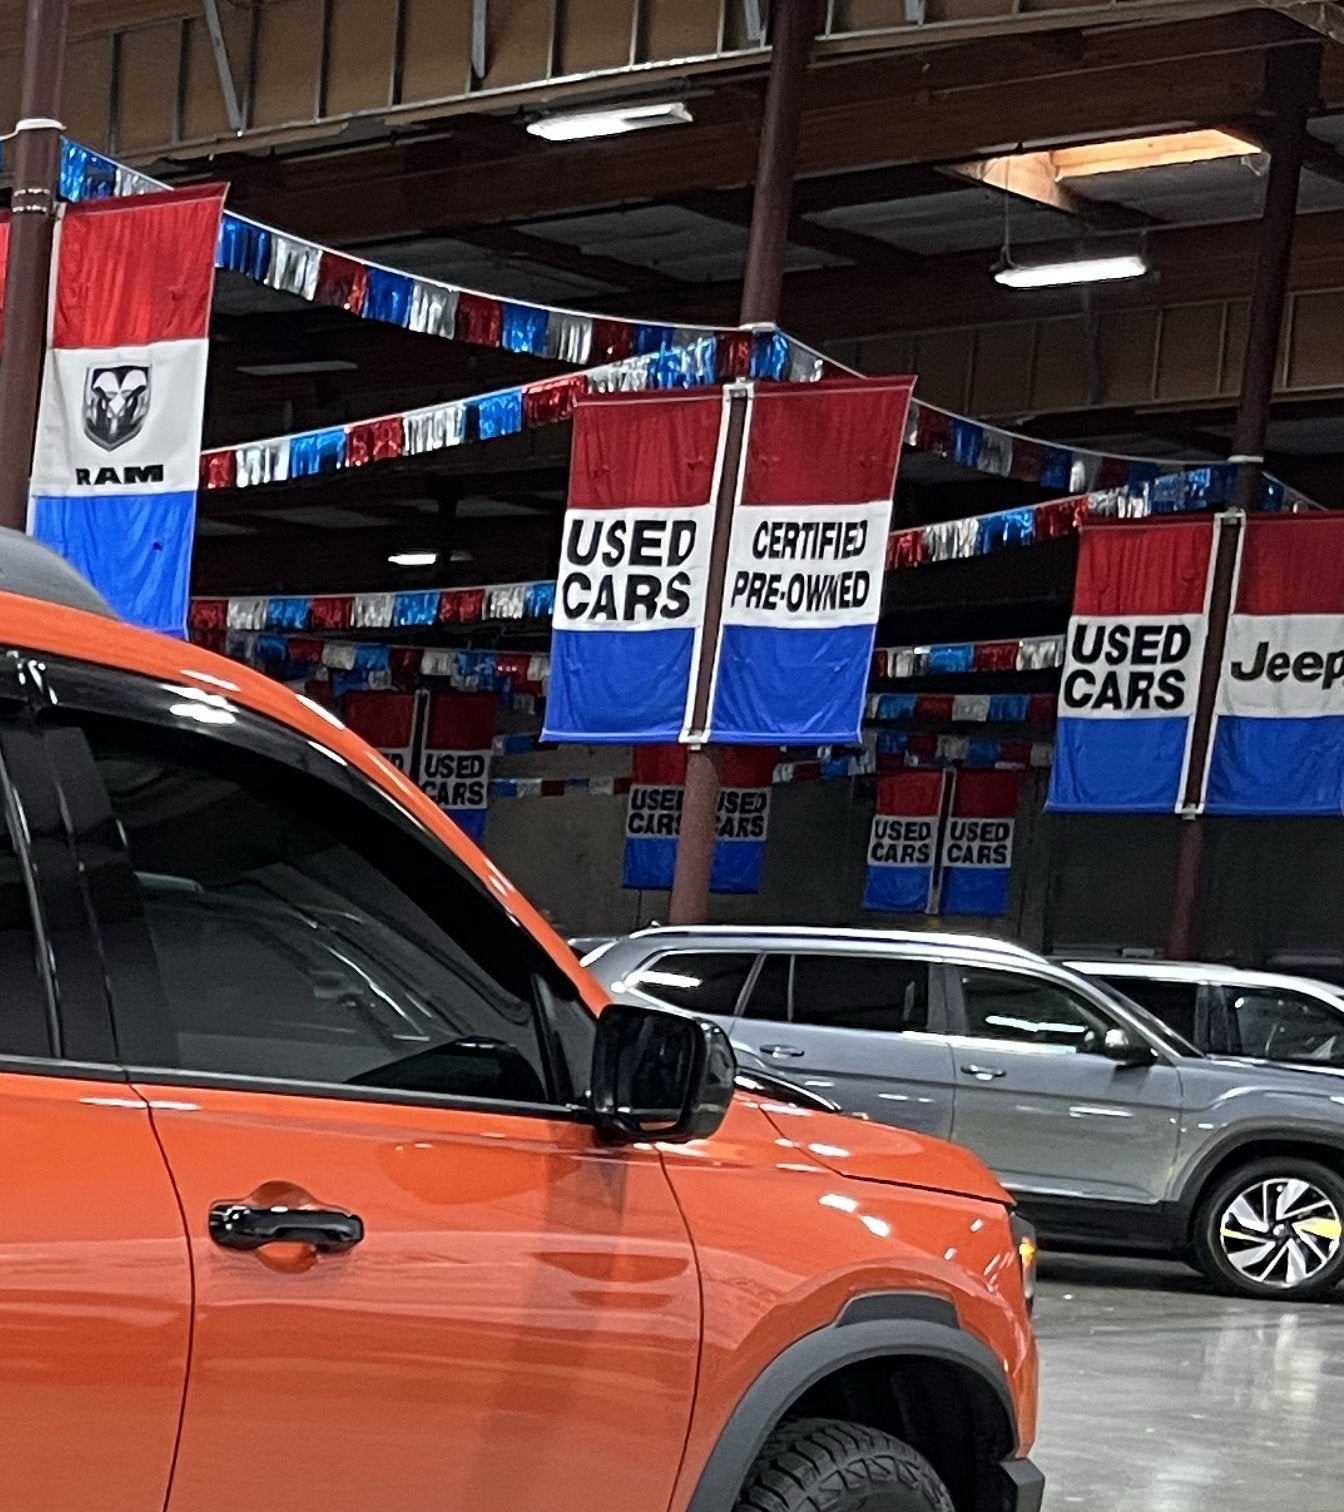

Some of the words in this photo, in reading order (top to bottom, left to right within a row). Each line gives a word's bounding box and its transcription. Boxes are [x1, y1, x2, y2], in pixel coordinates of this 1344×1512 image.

[76, 464, 164, 486] RAM
[566, 519, 697, 567] USED
[752, 519, 868, 560] CERTIFIED
[562, 571, 691, 621] CARS
[731, 570, 871, 612] PRE-OWNED
[1071, 624, 1191, 665] USED
[1231, 641, 1344, 690] Jeep
[1064, 669, 1185, 710] CARS
[424, 754, 485, 779] USED
[715, 815, 765, 837] ARS
[874, 820, 931, 841] USED
[950, 821, 1010, 842] USED
[871, 842, 930, 863] CARS
[947, 843, 1008, 864] CARS
